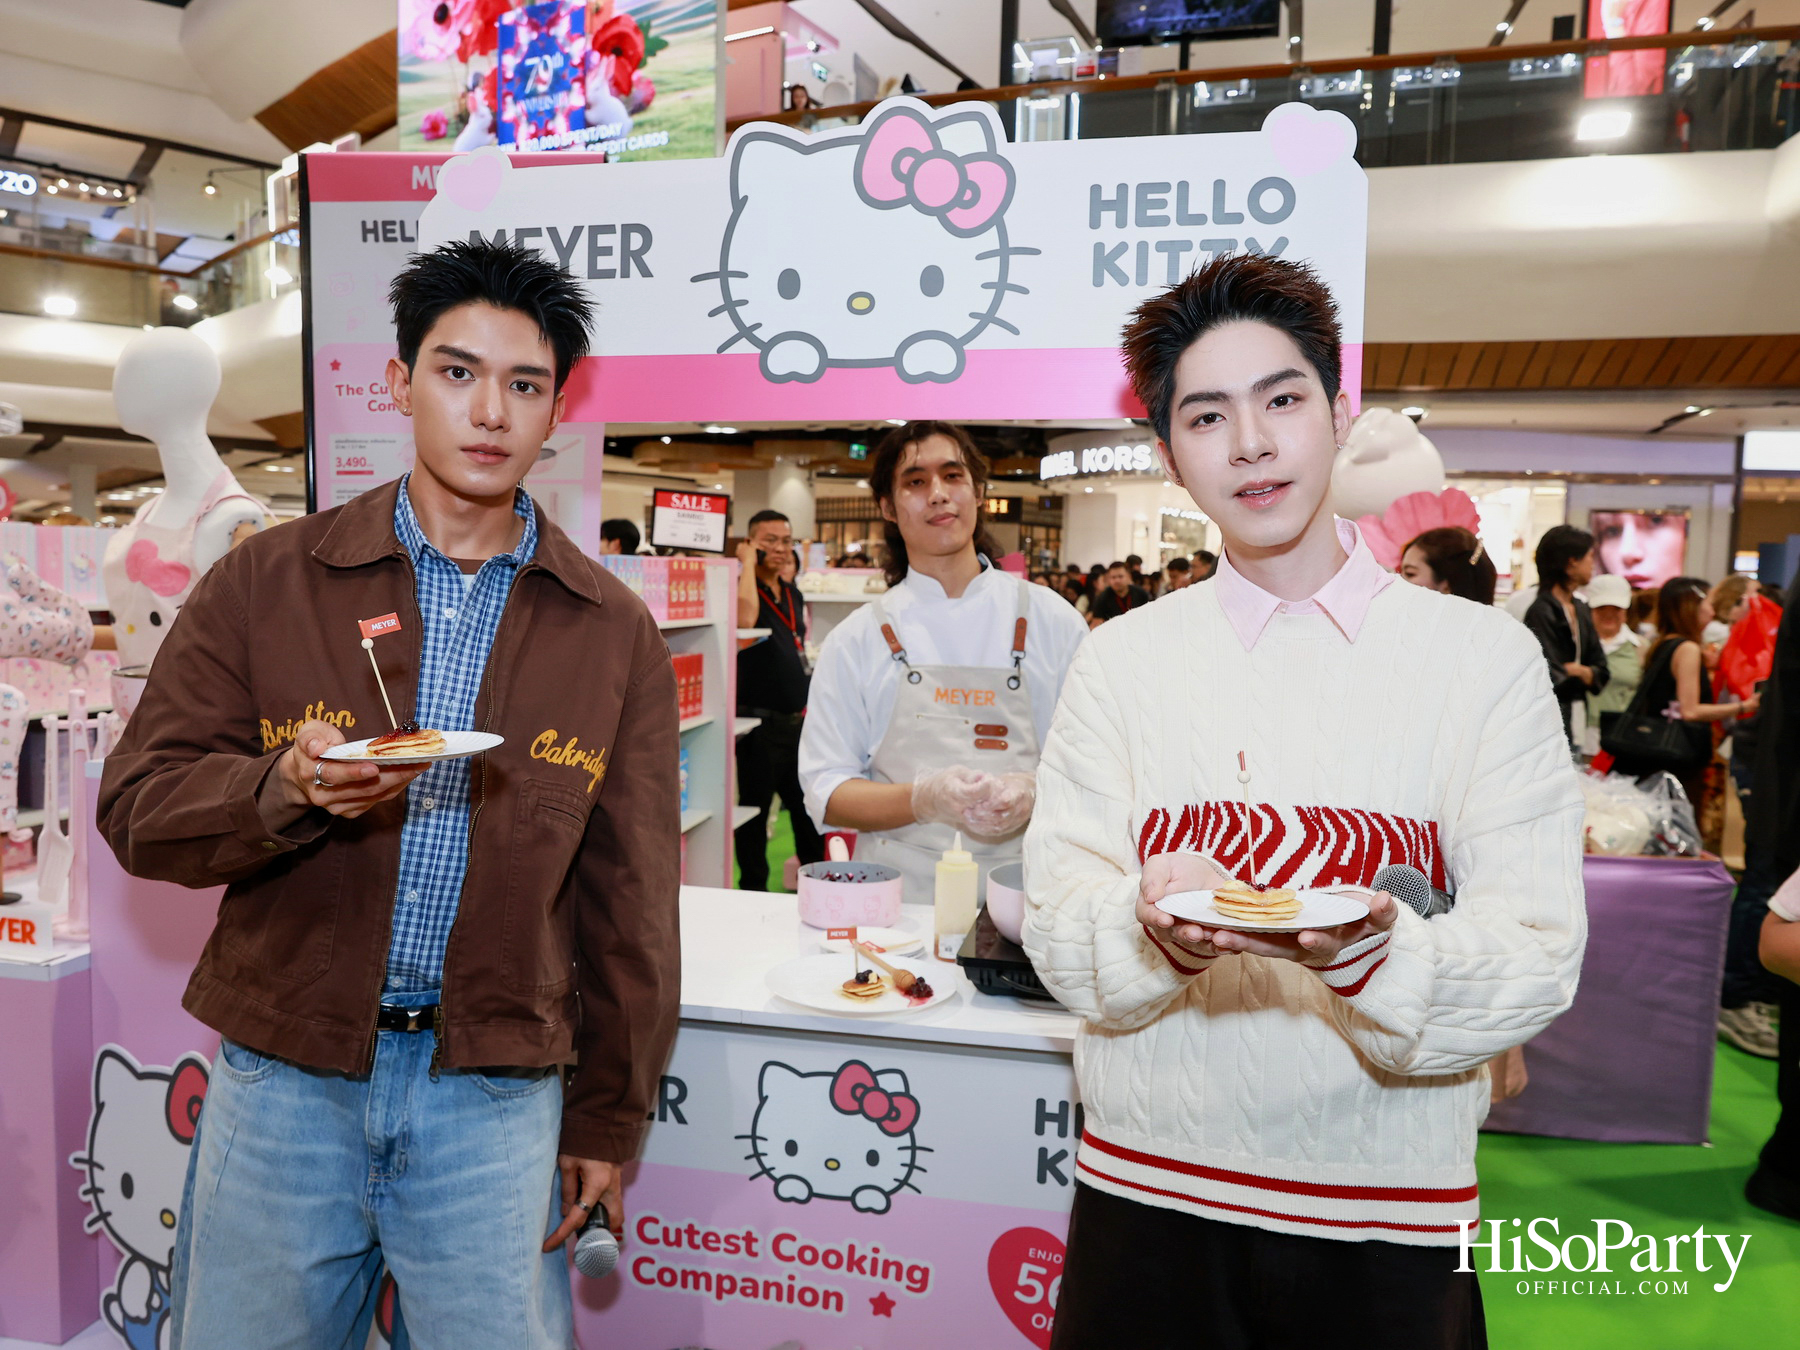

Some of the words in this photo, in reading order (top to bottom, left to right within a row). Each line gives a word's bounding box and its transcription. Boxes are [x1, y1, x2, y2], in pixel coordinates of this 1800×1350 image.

[627, 130, 669, 151] CARDS
[1089, 177, 1296, 229] HELLO
[361, 220, 419, 243] HEL
[335, 384, 364, 396] The
[336, 457, 367, 468] 3,490
[1082, 444, 1152, 473] KORS
[671, 493, 712, 511] SALE
[371, 618, 397, 631] MEYER
[934, 687, 996, 707] MEYER
[646, 1075, 688, 1125] R
[636, 1216, 759, 1258] Cutest
[771, 1232, 930, 1294] Cooking
[631, 1256, 844, 1313] Companion
